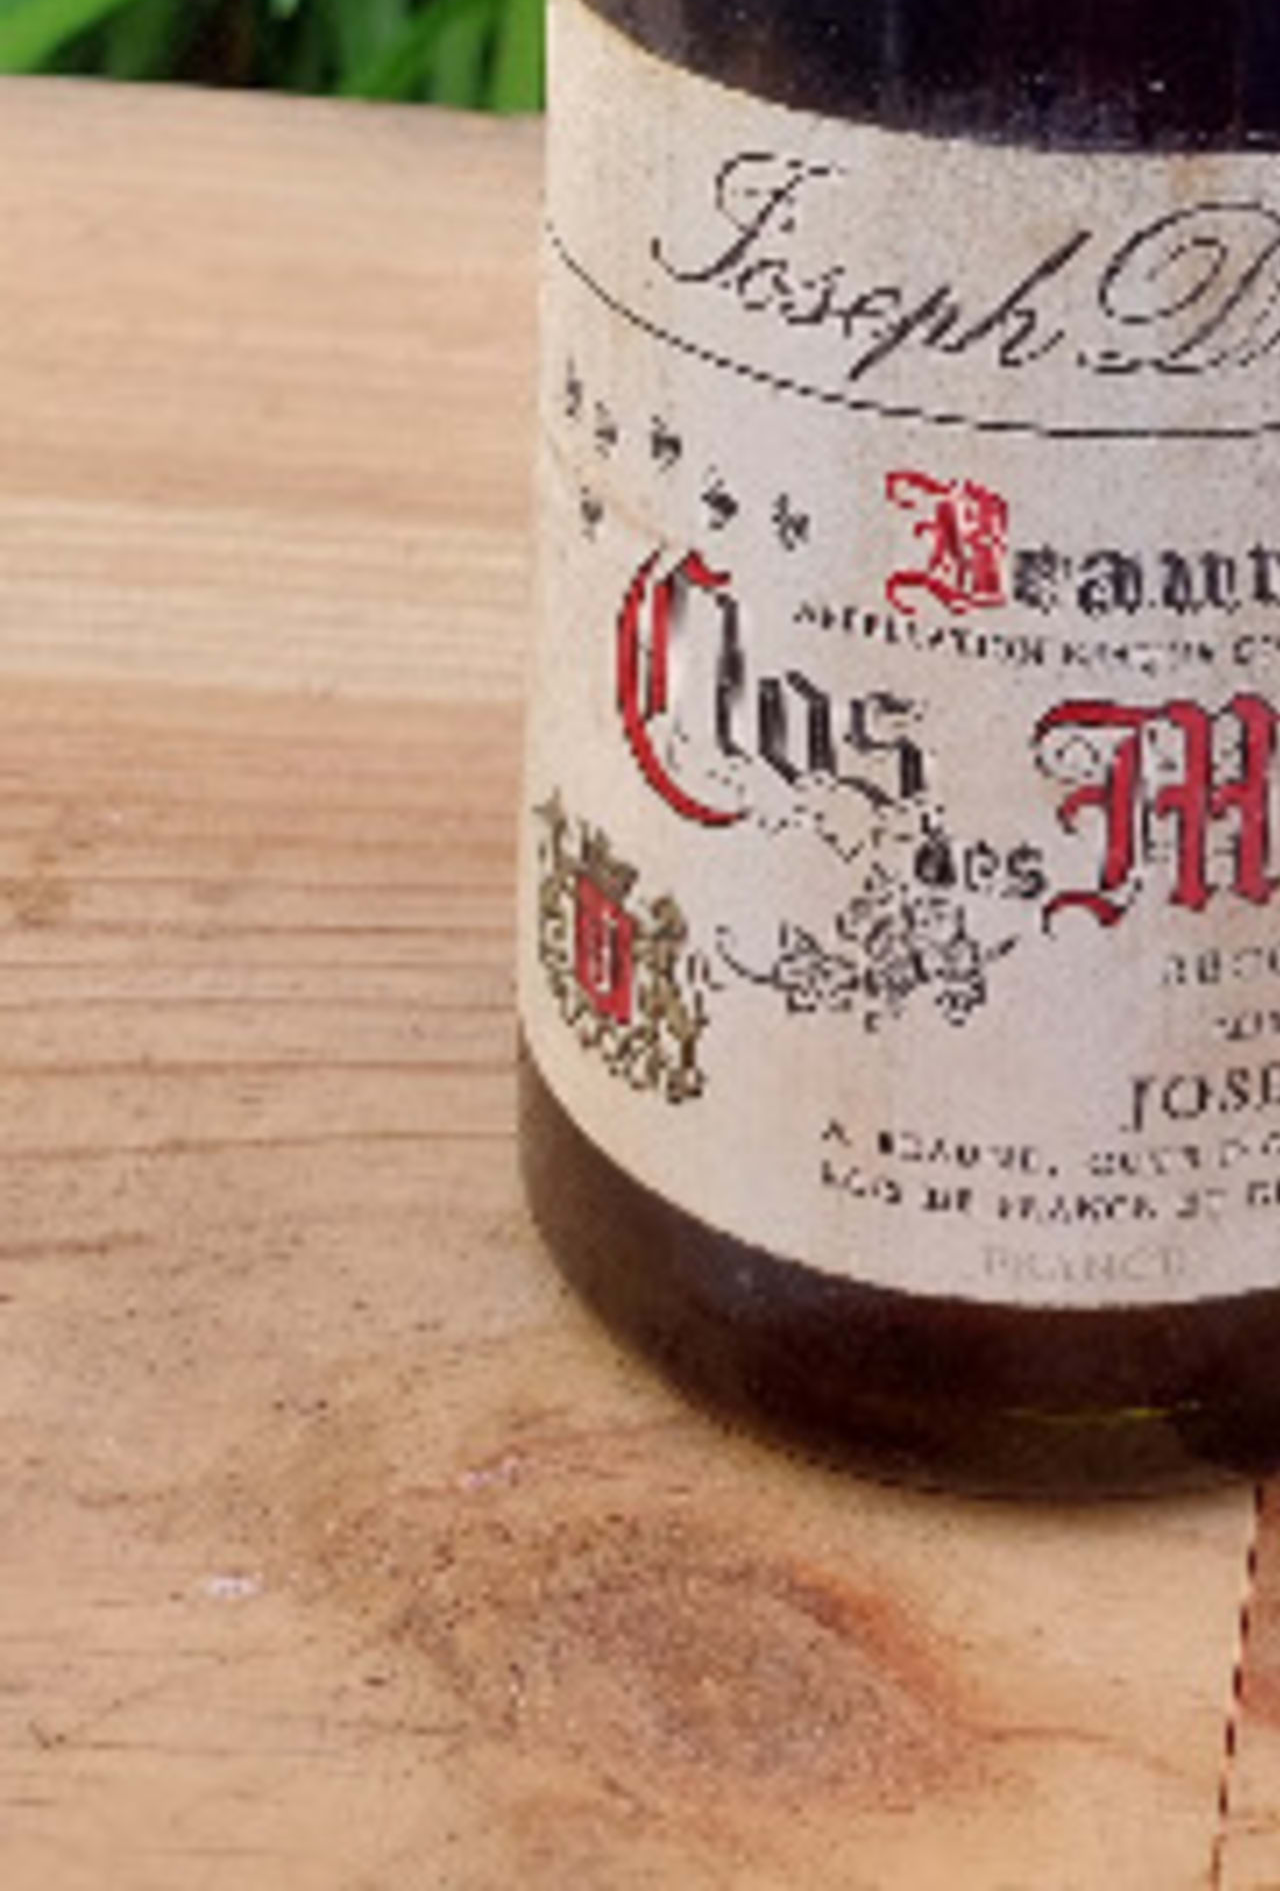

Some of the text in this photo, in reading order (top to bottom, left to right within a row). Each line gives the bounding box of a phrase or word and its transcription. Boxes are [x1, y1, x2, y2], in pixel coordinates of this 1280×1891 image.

[650, 151, 1092, 381] Joseph
[617, 546, 924, 827] Clos
[912, 812, 1046, 899] des
